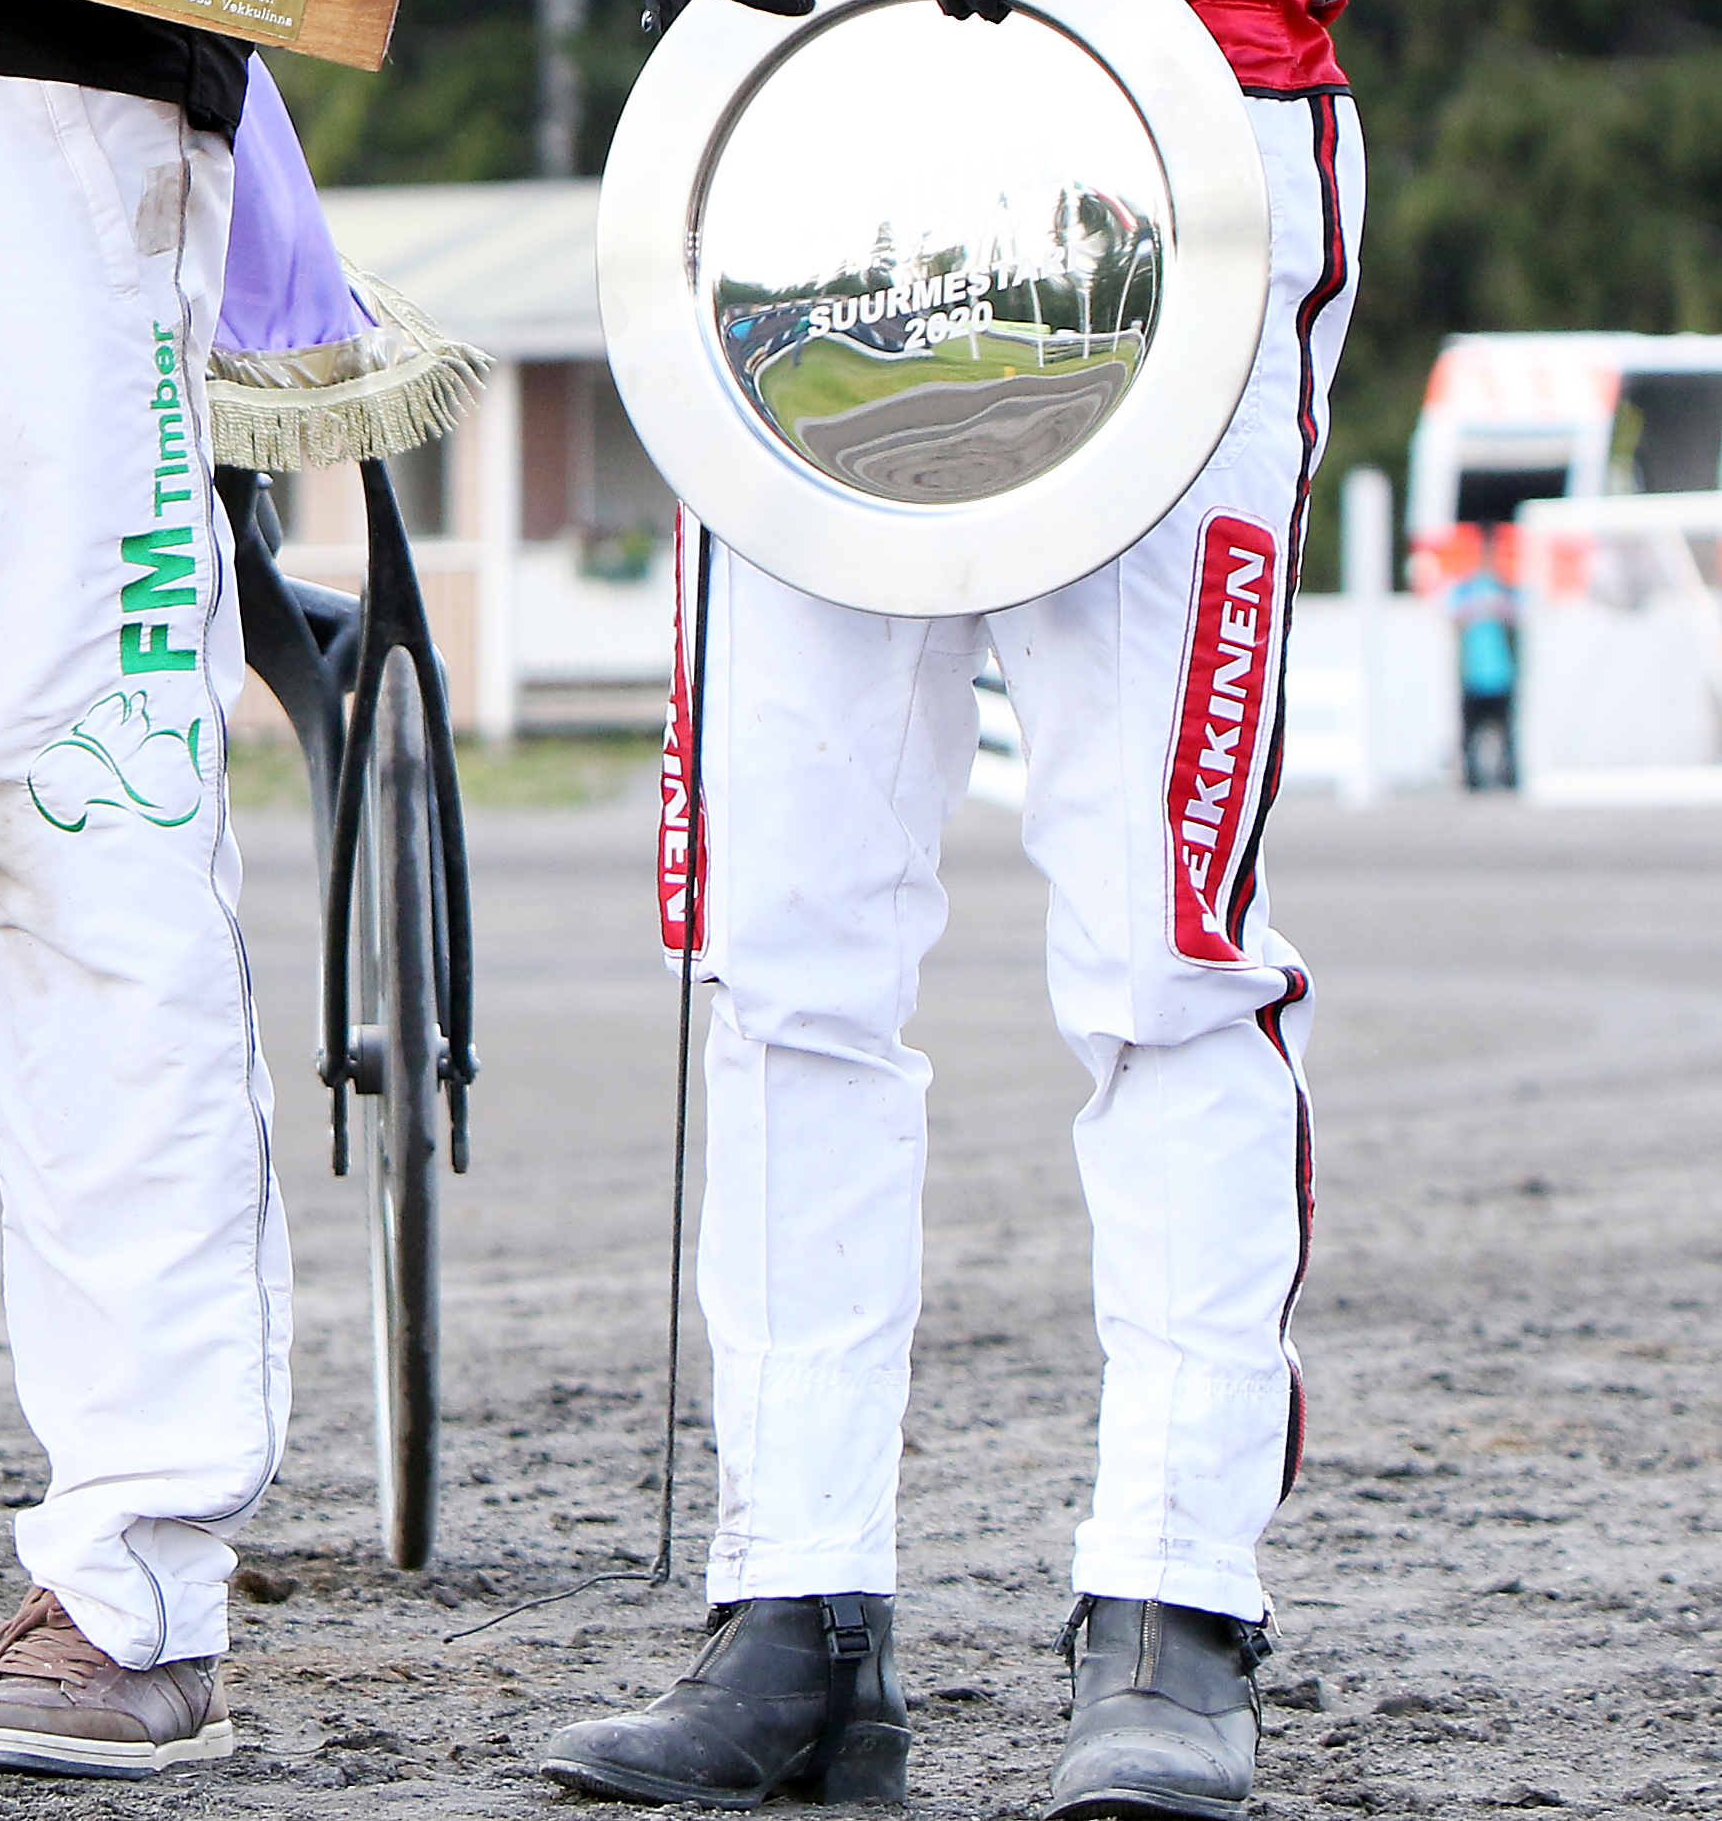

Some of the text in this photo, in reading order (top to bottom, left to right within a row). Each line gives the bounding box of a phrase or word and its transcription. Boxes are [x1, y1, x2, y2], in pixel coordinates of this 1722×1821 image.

[807, 244, 1082, 339] SUURMESTARI
[904, 300, 993, 352] 2020
[120, 528, 197, 676] FM
